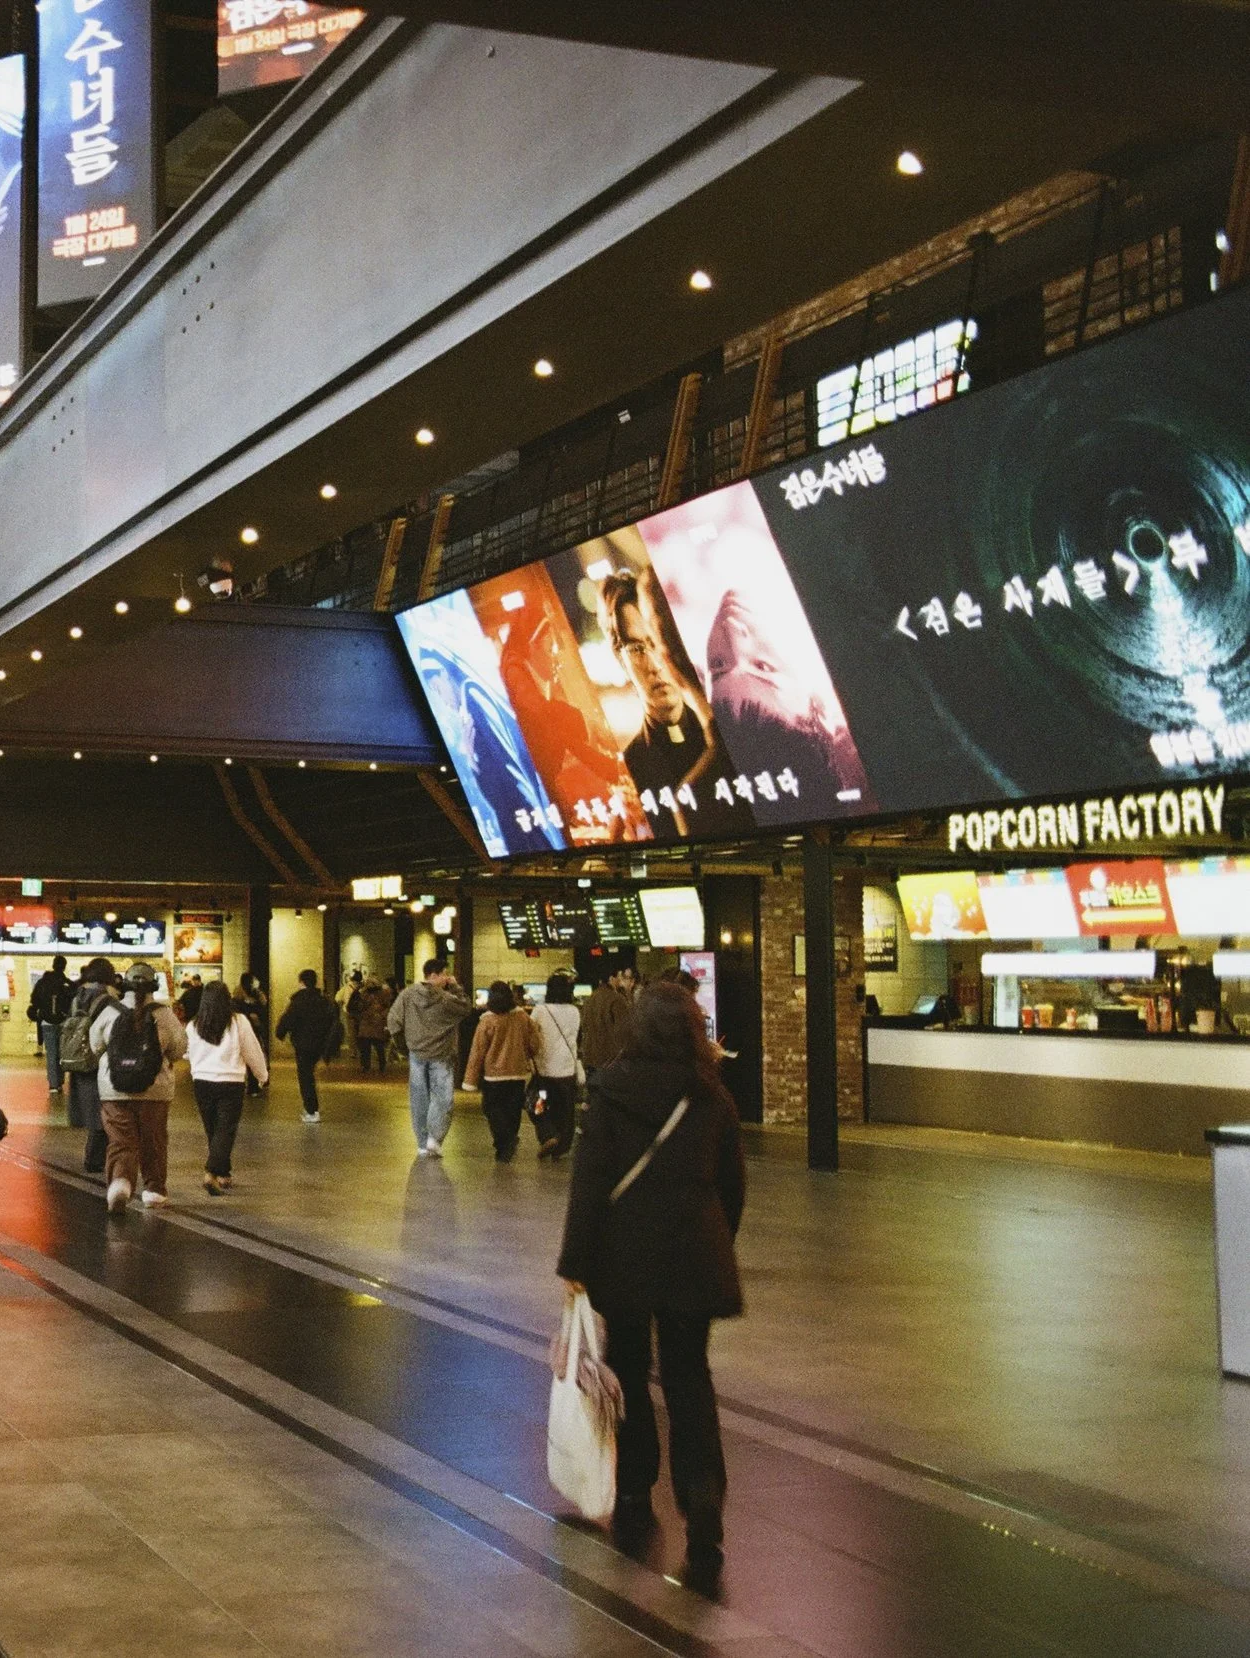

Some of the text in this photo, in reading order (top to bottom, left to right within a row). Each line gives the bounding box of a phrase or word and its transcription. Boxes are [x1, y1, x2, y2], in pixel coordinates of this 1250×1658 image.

[88, 206, 124, 232] 24일
[52, 236, 86, 258] 극장
[949, 784, 1224, 853] POPCORN FACTORY
